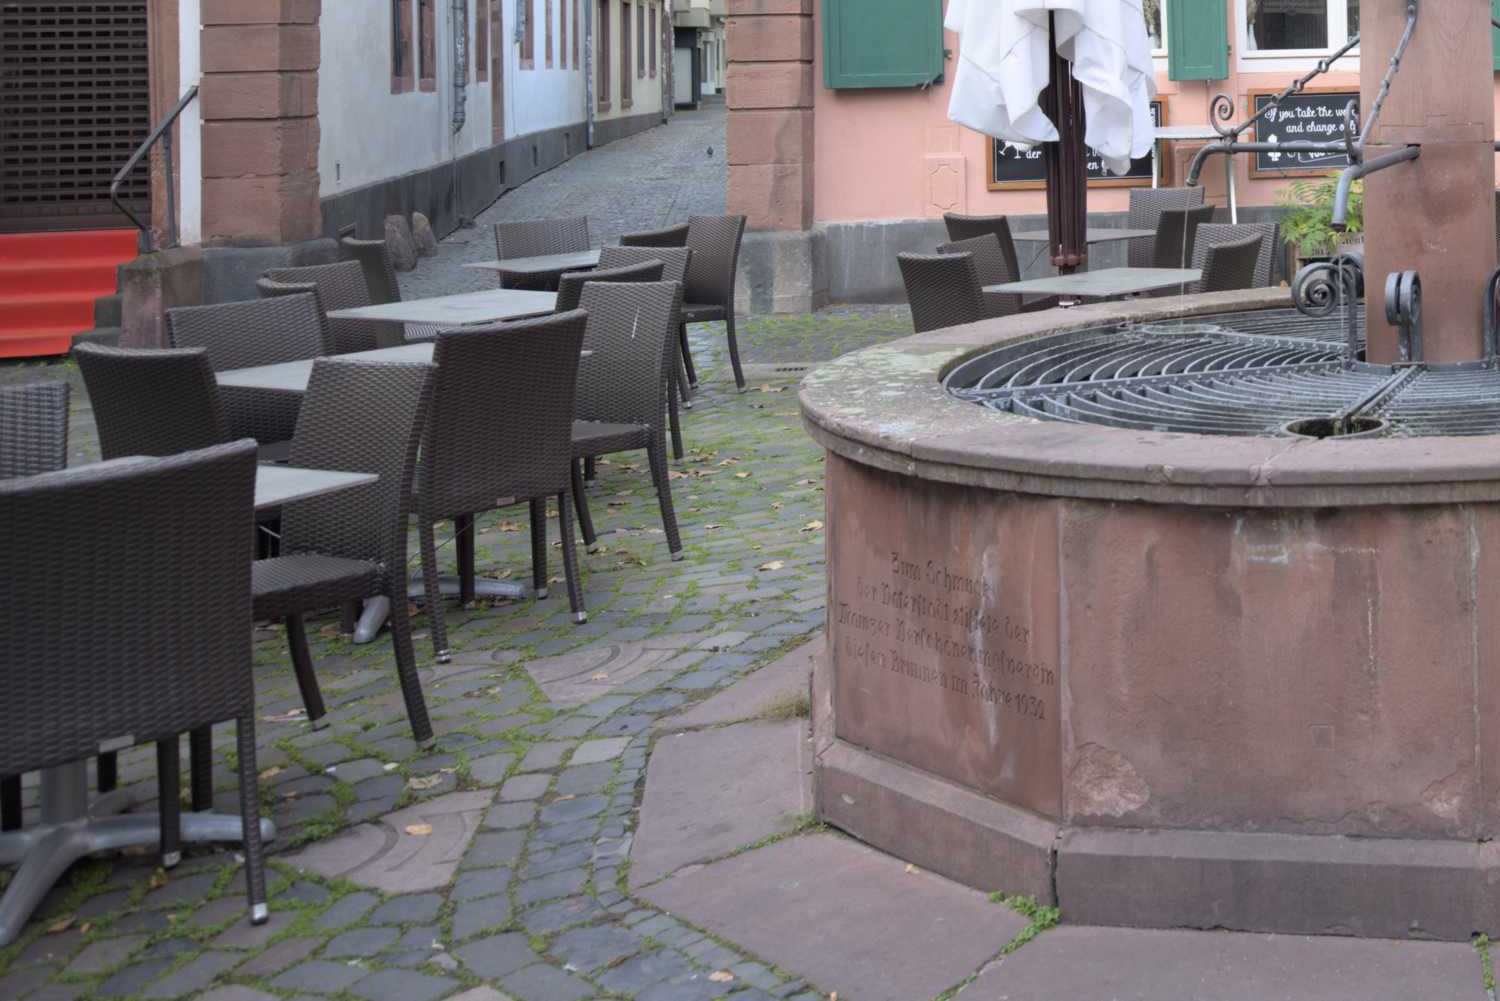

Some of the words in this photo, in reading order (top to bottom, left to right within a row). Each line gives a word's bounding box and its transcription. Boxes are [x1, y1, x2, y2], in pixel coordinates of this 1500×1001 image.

[1279, 109, 1294, 122] you
[1296, 106, 1317, 119] take
[1317, 106, 1334, 118] the
[1286, 121, 1304, 133] and
[1306, 121, 1338, 135] change
[1025, 150, 1042, 159] der
[890, 551, 922, 582] Zum
